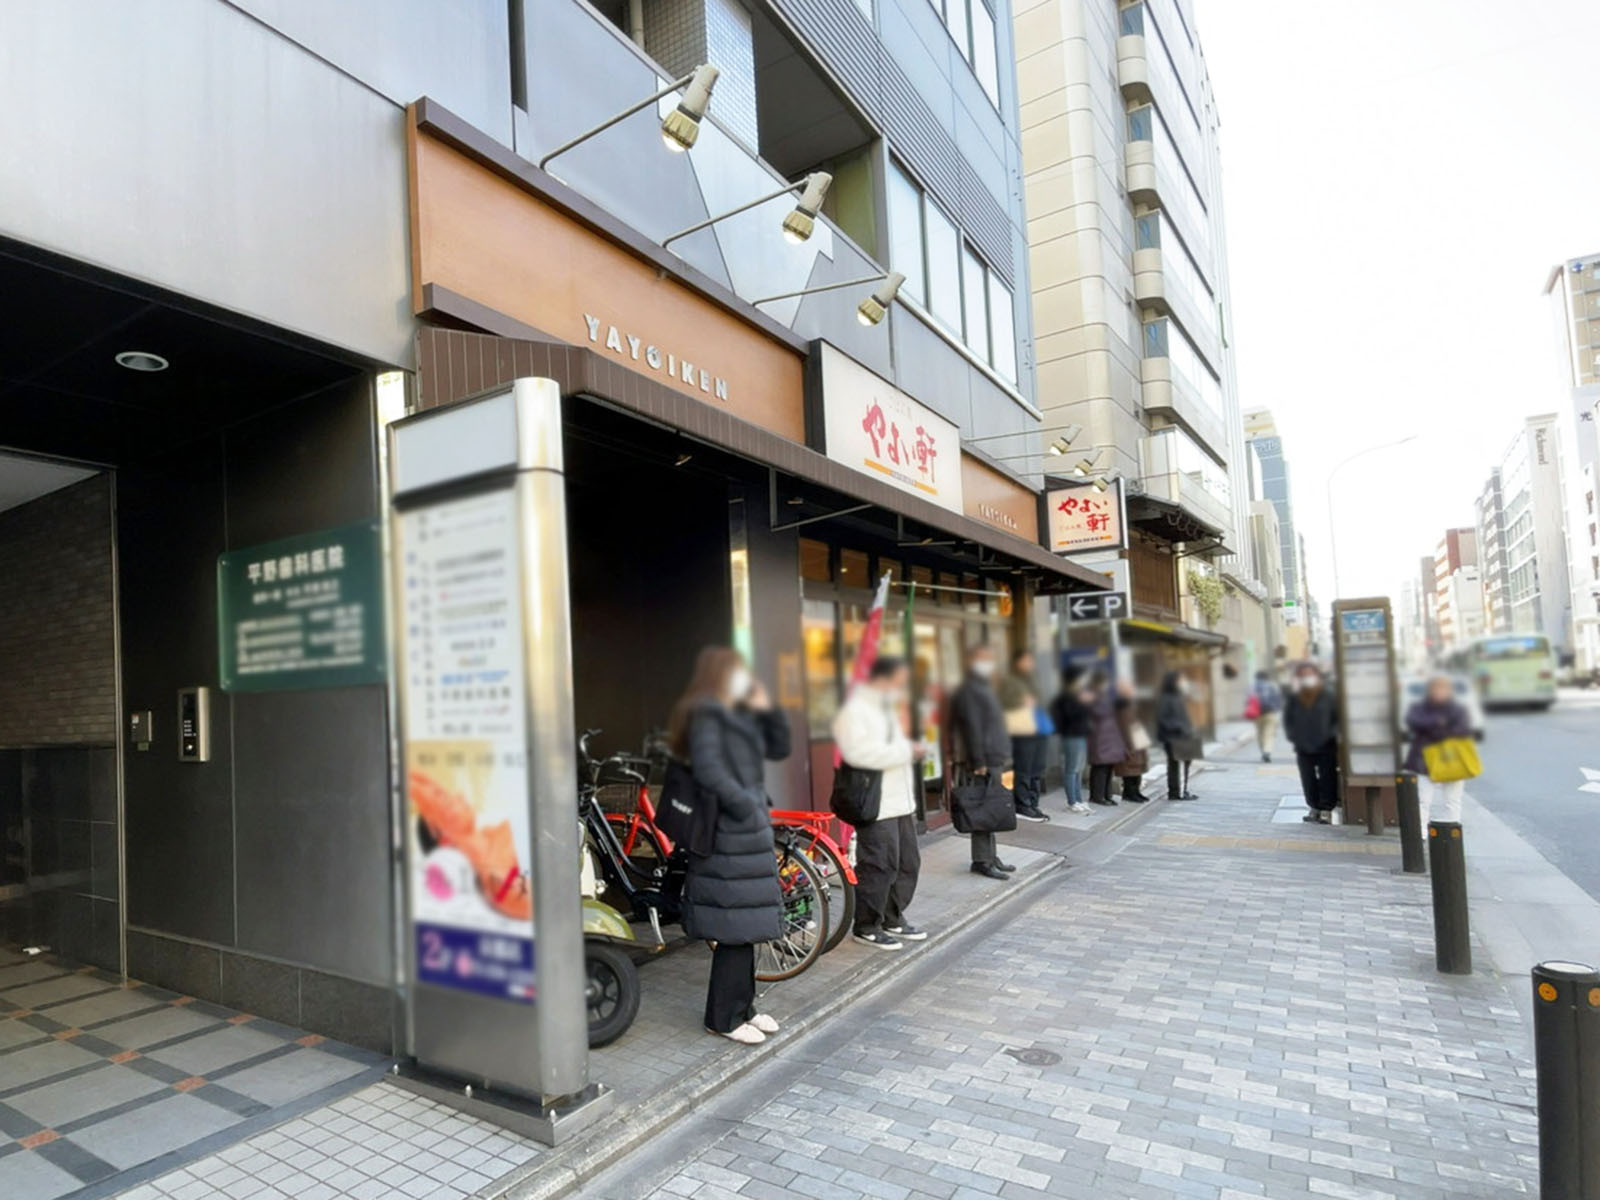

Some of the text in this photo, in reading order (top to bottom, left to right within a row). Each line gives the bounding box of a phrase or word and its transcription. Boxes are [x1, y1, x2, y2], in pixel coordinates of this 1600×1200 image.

[583, 312, 728, 401] YAYOIKEN
[862, 397, 937, 484] やよい軒
[1058, 497, 1108, 516] やよい
[1086, 513, 1111, 532] 軒
[1105, 596, 1122, 618] P
